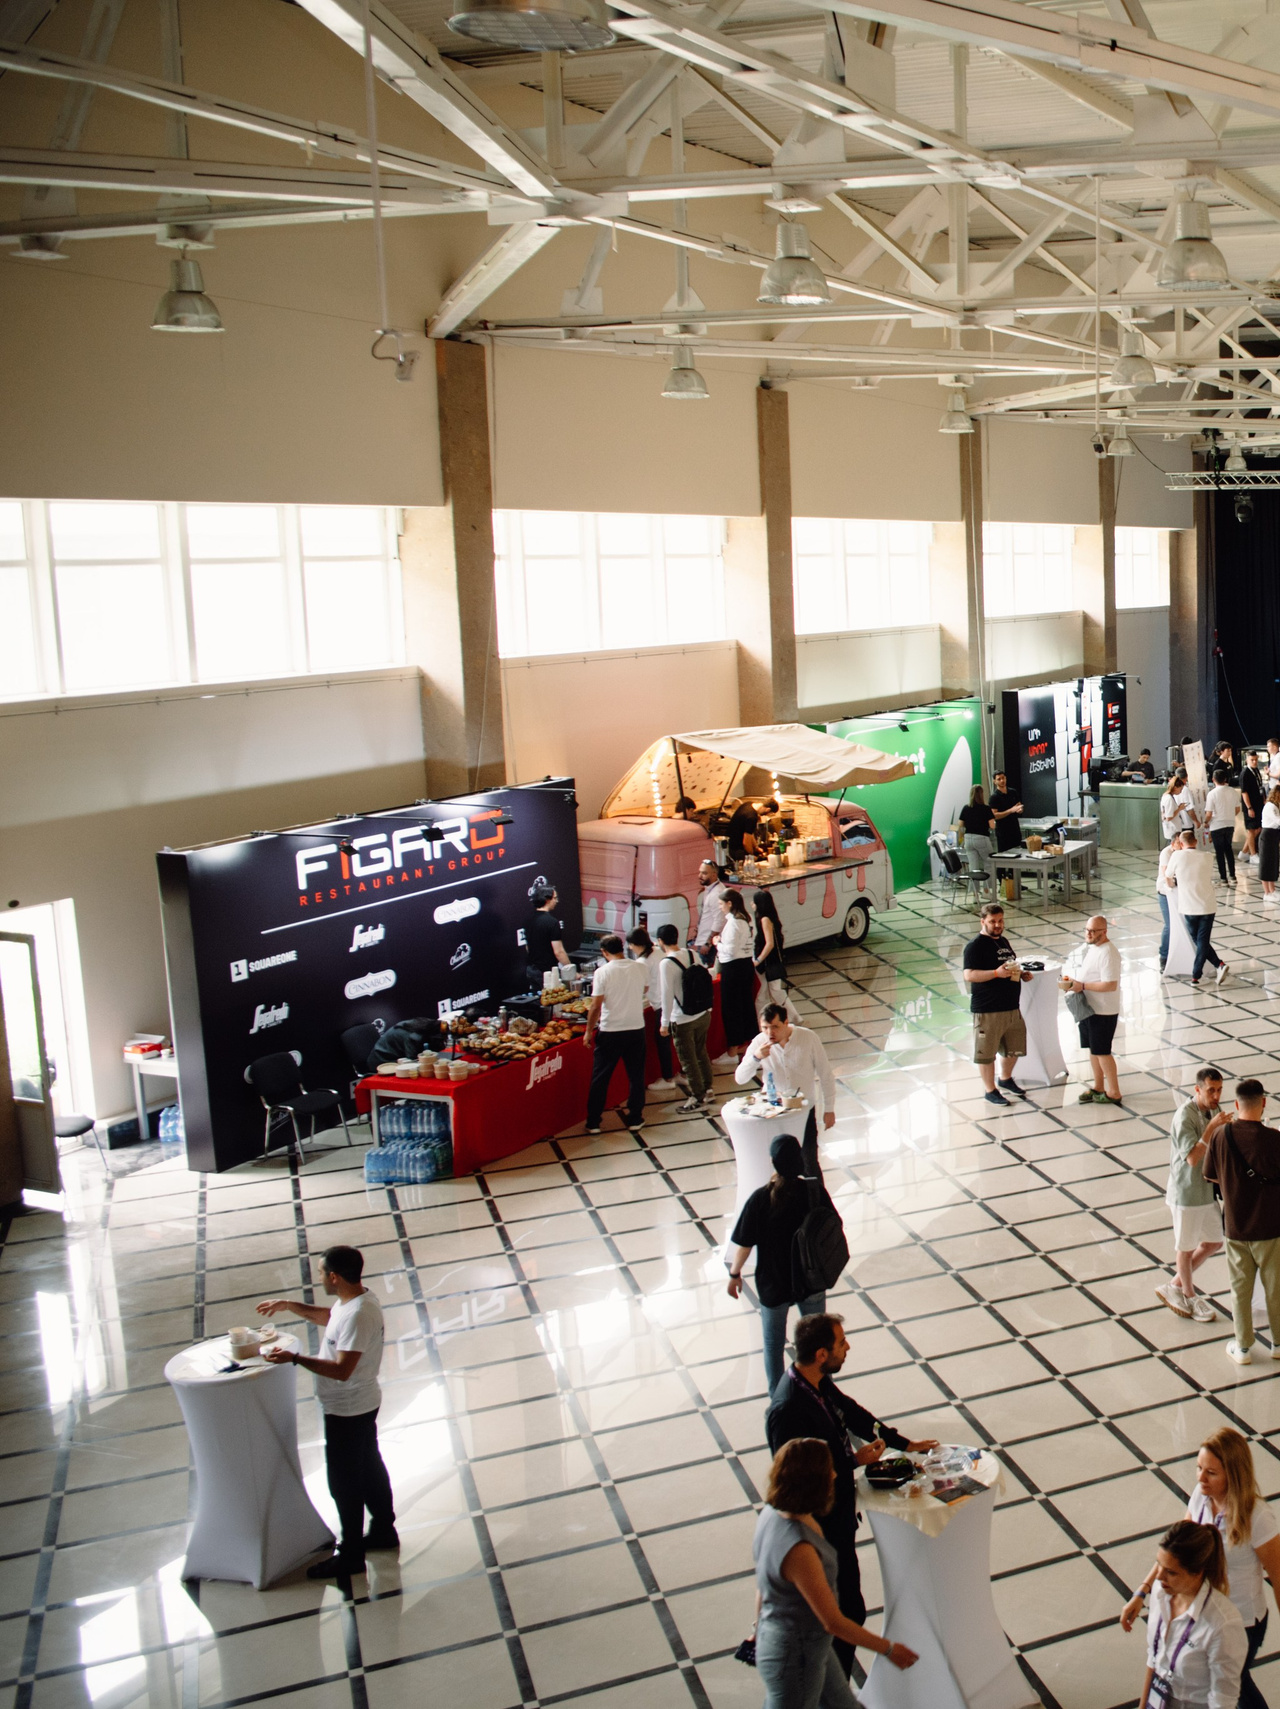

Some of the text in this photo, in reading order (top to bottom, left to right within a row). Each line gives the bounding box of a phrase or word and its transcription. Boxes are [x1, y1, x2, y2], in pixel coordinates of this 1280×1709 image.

[296, 809, 505, 890] FIGARO
[299, 848, 506, 907] RESTAURANT GROUP
[249, 950, 298, 972] SQUAREONE
[348, 974, 393, 996] CINNABON
[452, 989, 490, 1010] SQUAREONE
